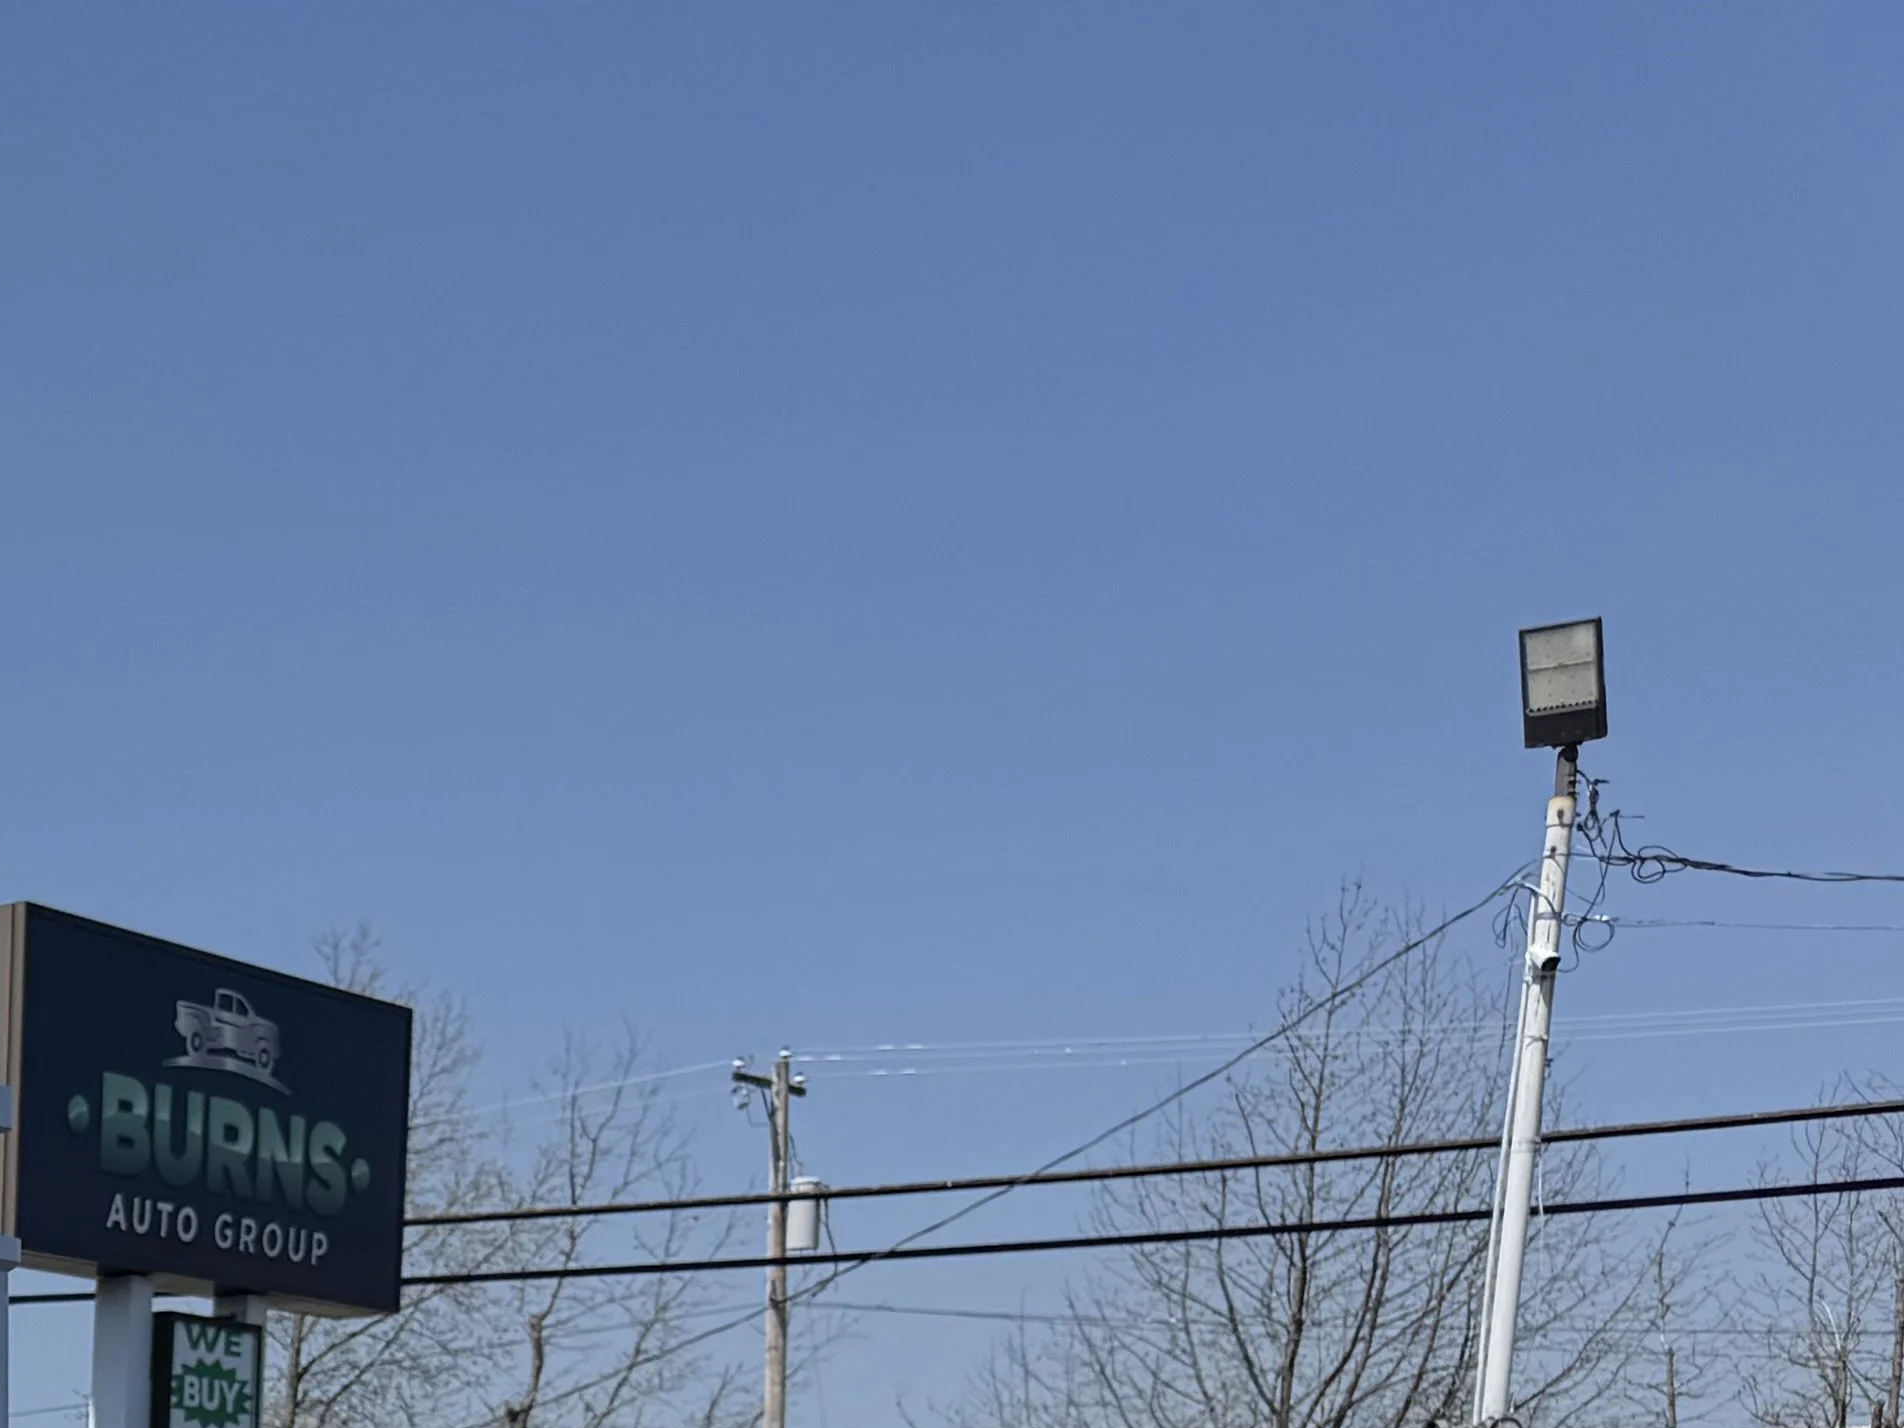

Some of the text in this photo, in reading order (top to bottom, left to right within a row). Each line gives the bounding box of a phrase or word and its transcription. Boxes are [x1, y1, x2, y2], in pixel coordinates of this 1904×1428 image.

[100, 1071, 348, 1217] BURNS
[106, 1193, 329, 1266] AUTO GROUP
[186, 1322, 242, 1357] WE
[183, 1374, 242, 1414] BUY
